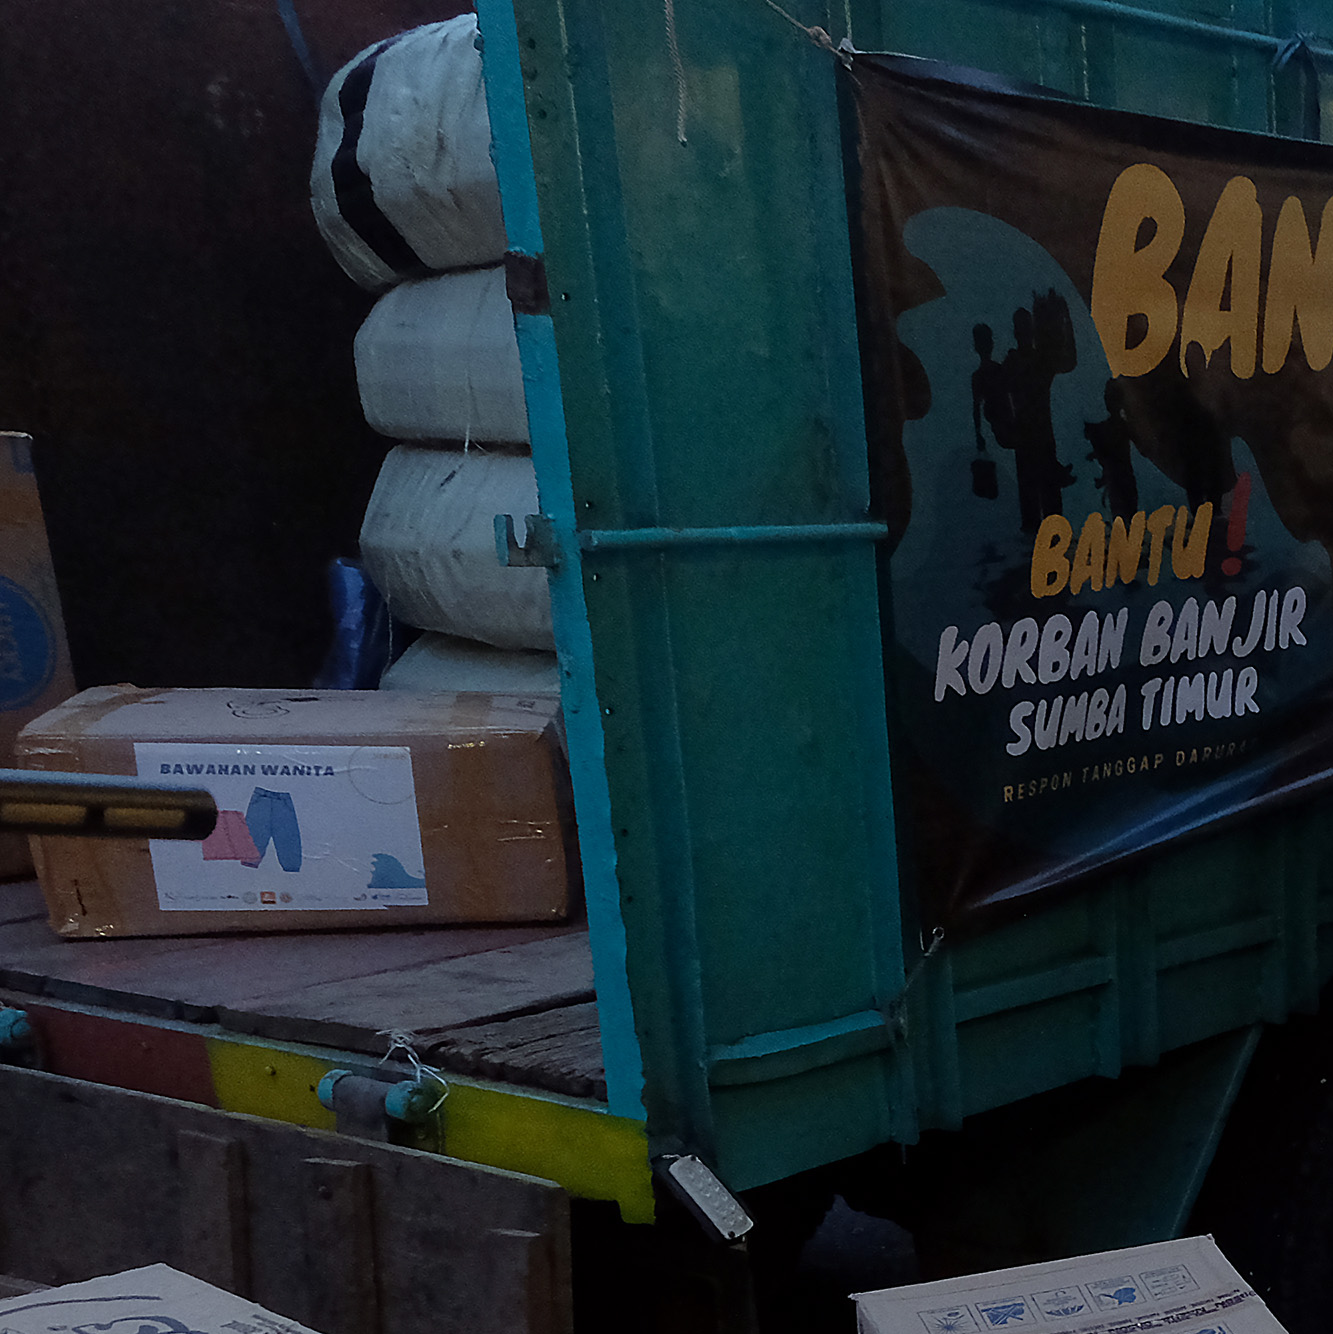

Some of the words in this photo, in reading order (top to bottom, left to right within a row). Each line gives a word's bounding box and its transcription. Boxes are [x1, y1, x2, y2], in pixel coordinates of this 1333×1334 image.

[934, 606, 1129, 702] KORBAN
[1138, 586, 1307, 666] BANJIR
[1005, 684, 1127, 757] SUMBA
[1140, 666, 1260, 731] TIMUR
[160, 763, 256, 777] BAWAHAN
[261, 764, 335, 778] WANITA
[1003, 773, 1073, 804] RESPON
[1081, 752, 1164, 786] TANGGAP
